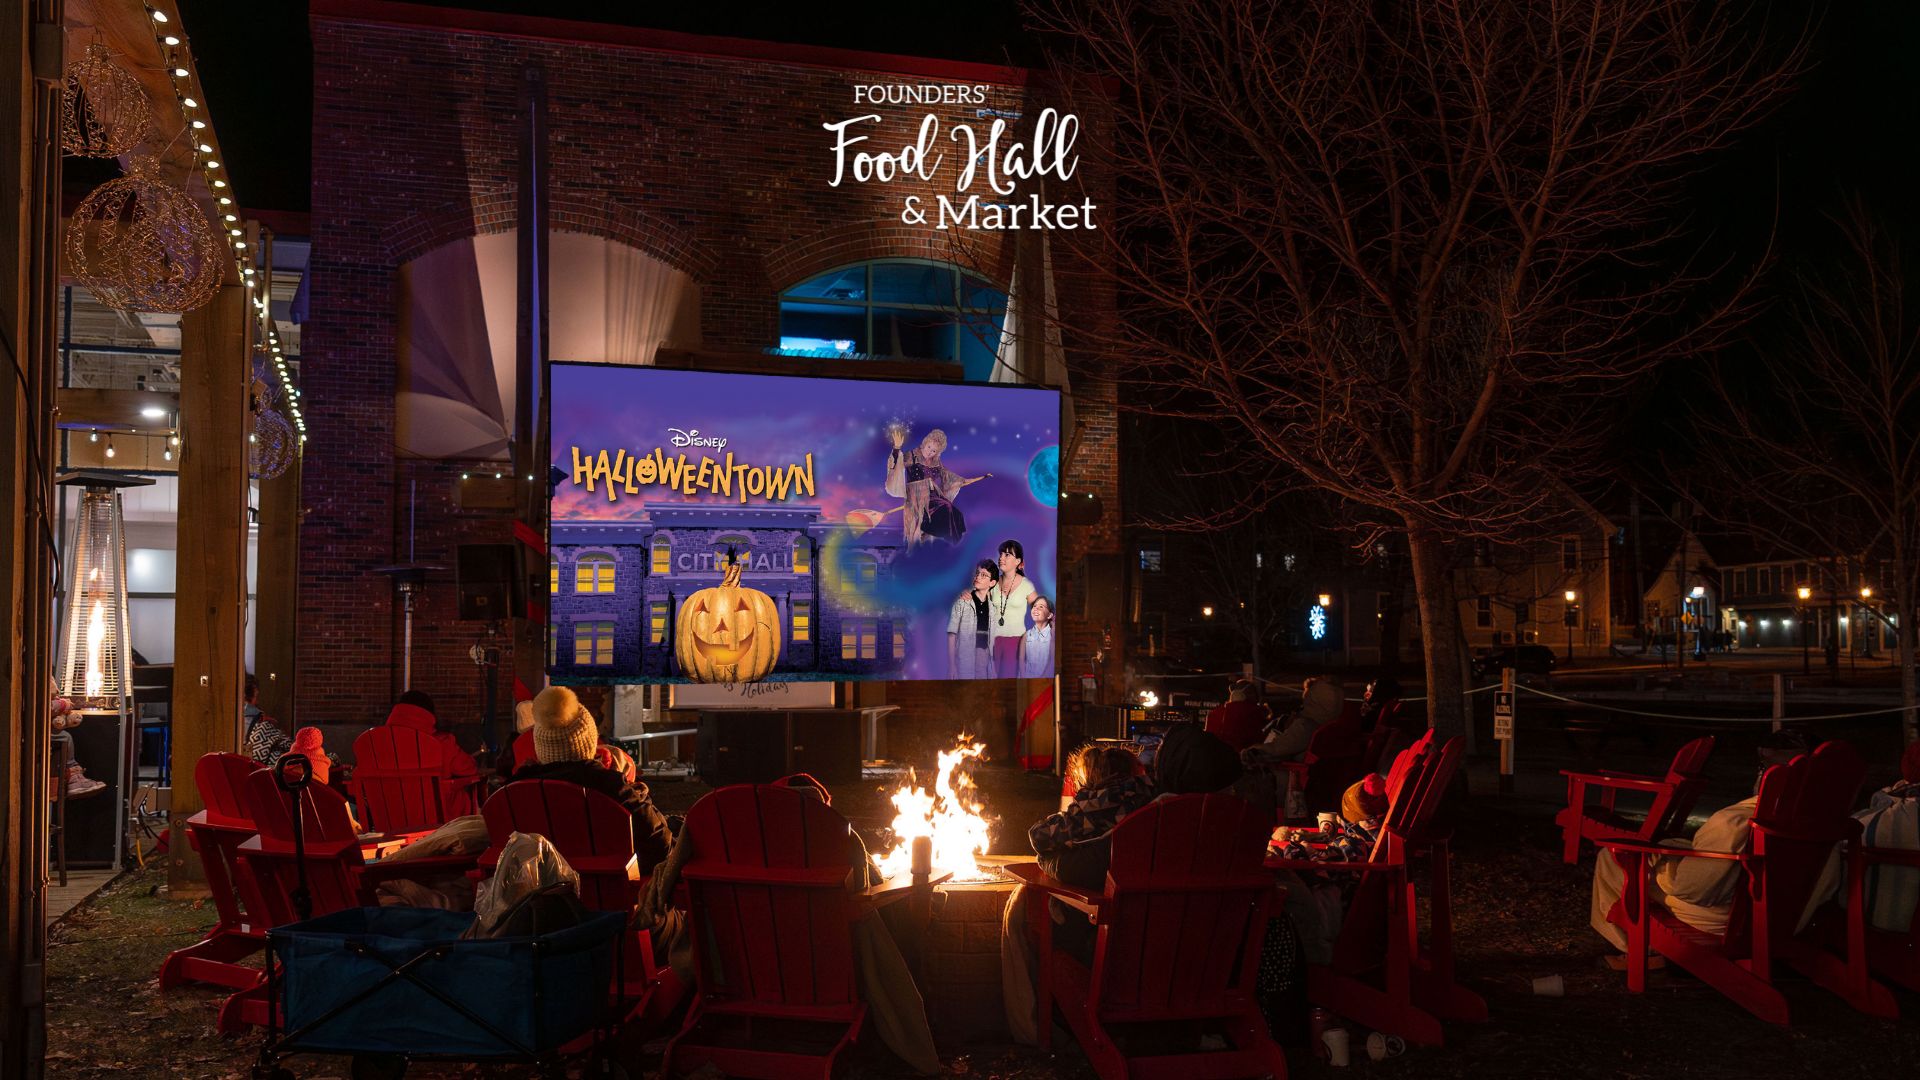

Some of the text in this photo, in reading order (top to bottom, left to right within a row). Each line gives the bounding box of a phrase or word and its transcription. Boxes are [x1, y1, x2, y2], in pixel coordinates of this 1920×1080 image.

[668, 428, 727, 453] Disney
[571, 446, 815, 502] HALLOWEENTOWN
[677, 552, 794, 572] CITY HALL
